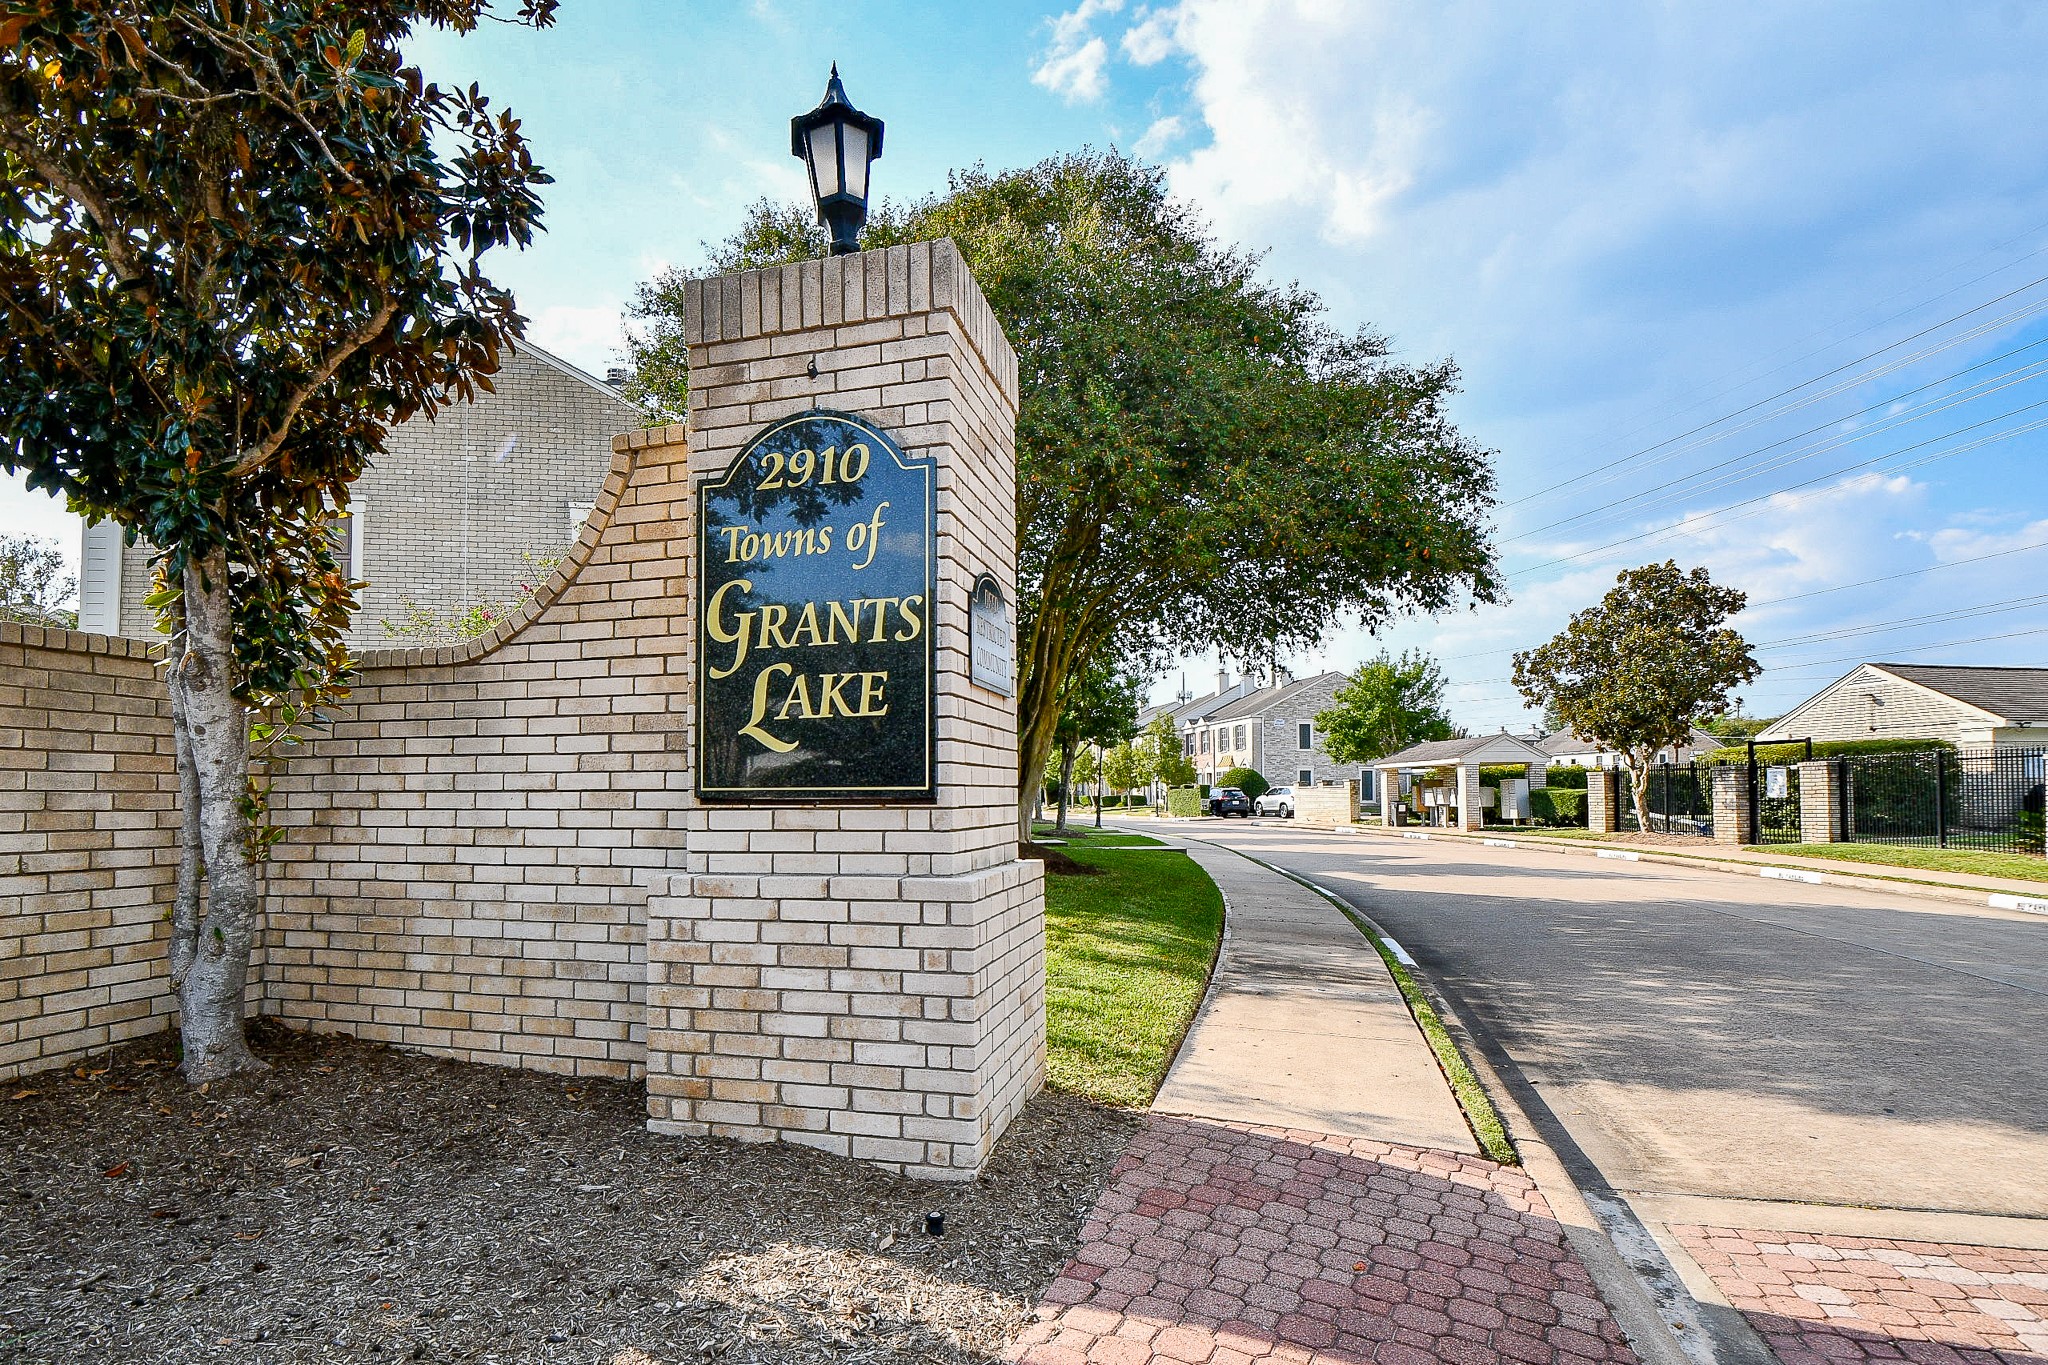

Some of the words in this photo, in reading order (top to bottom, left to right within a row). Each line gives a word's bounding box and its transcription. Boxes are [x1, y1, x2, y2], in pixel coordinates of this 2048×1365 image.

[756, 443, 870, 491] 2910
[720, 524, 833, 564] Towns
[846, 501, 890, 570] of
[706, 579, 923, 680] GRANTS
[737, 662, 890, 753] LAKE
